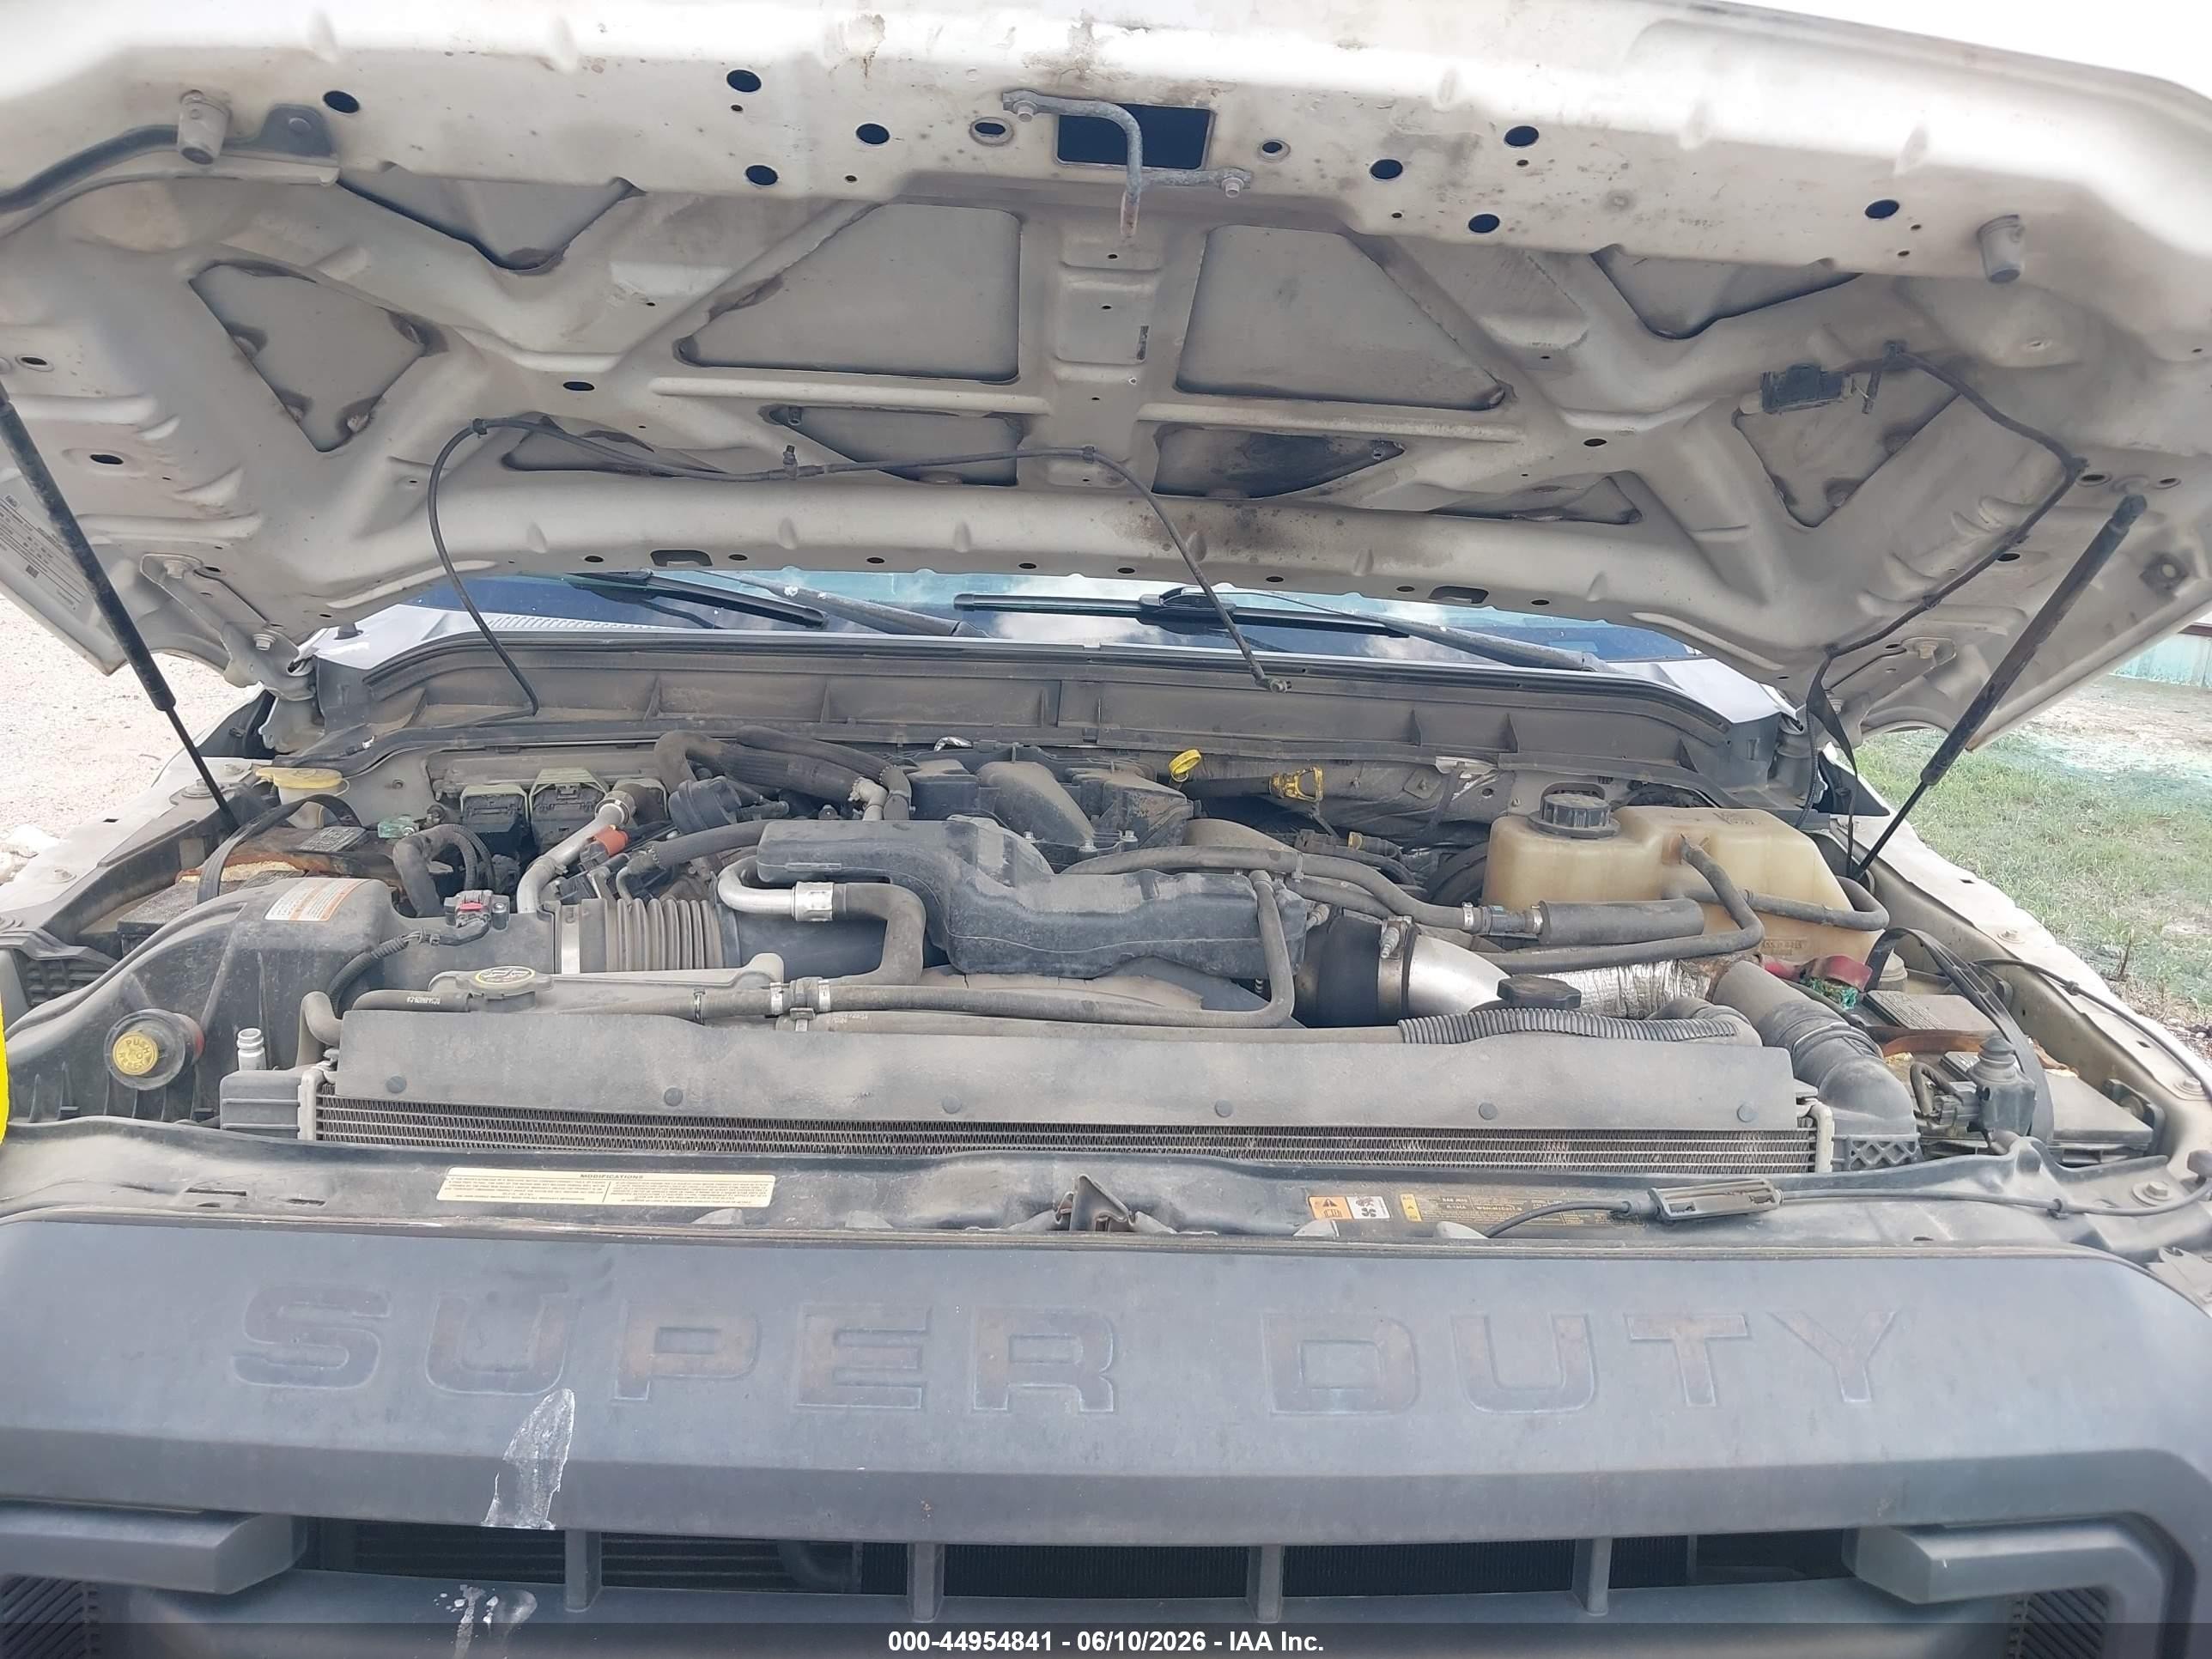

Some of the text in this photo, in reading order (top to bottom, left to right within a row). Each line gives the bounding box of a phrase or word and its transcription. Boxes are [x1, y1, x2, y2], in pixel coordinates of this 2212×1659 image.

[125, 1039, 150, 1054] PUSH
[232, 1288, 1899, 1415] SUPER DUTY
